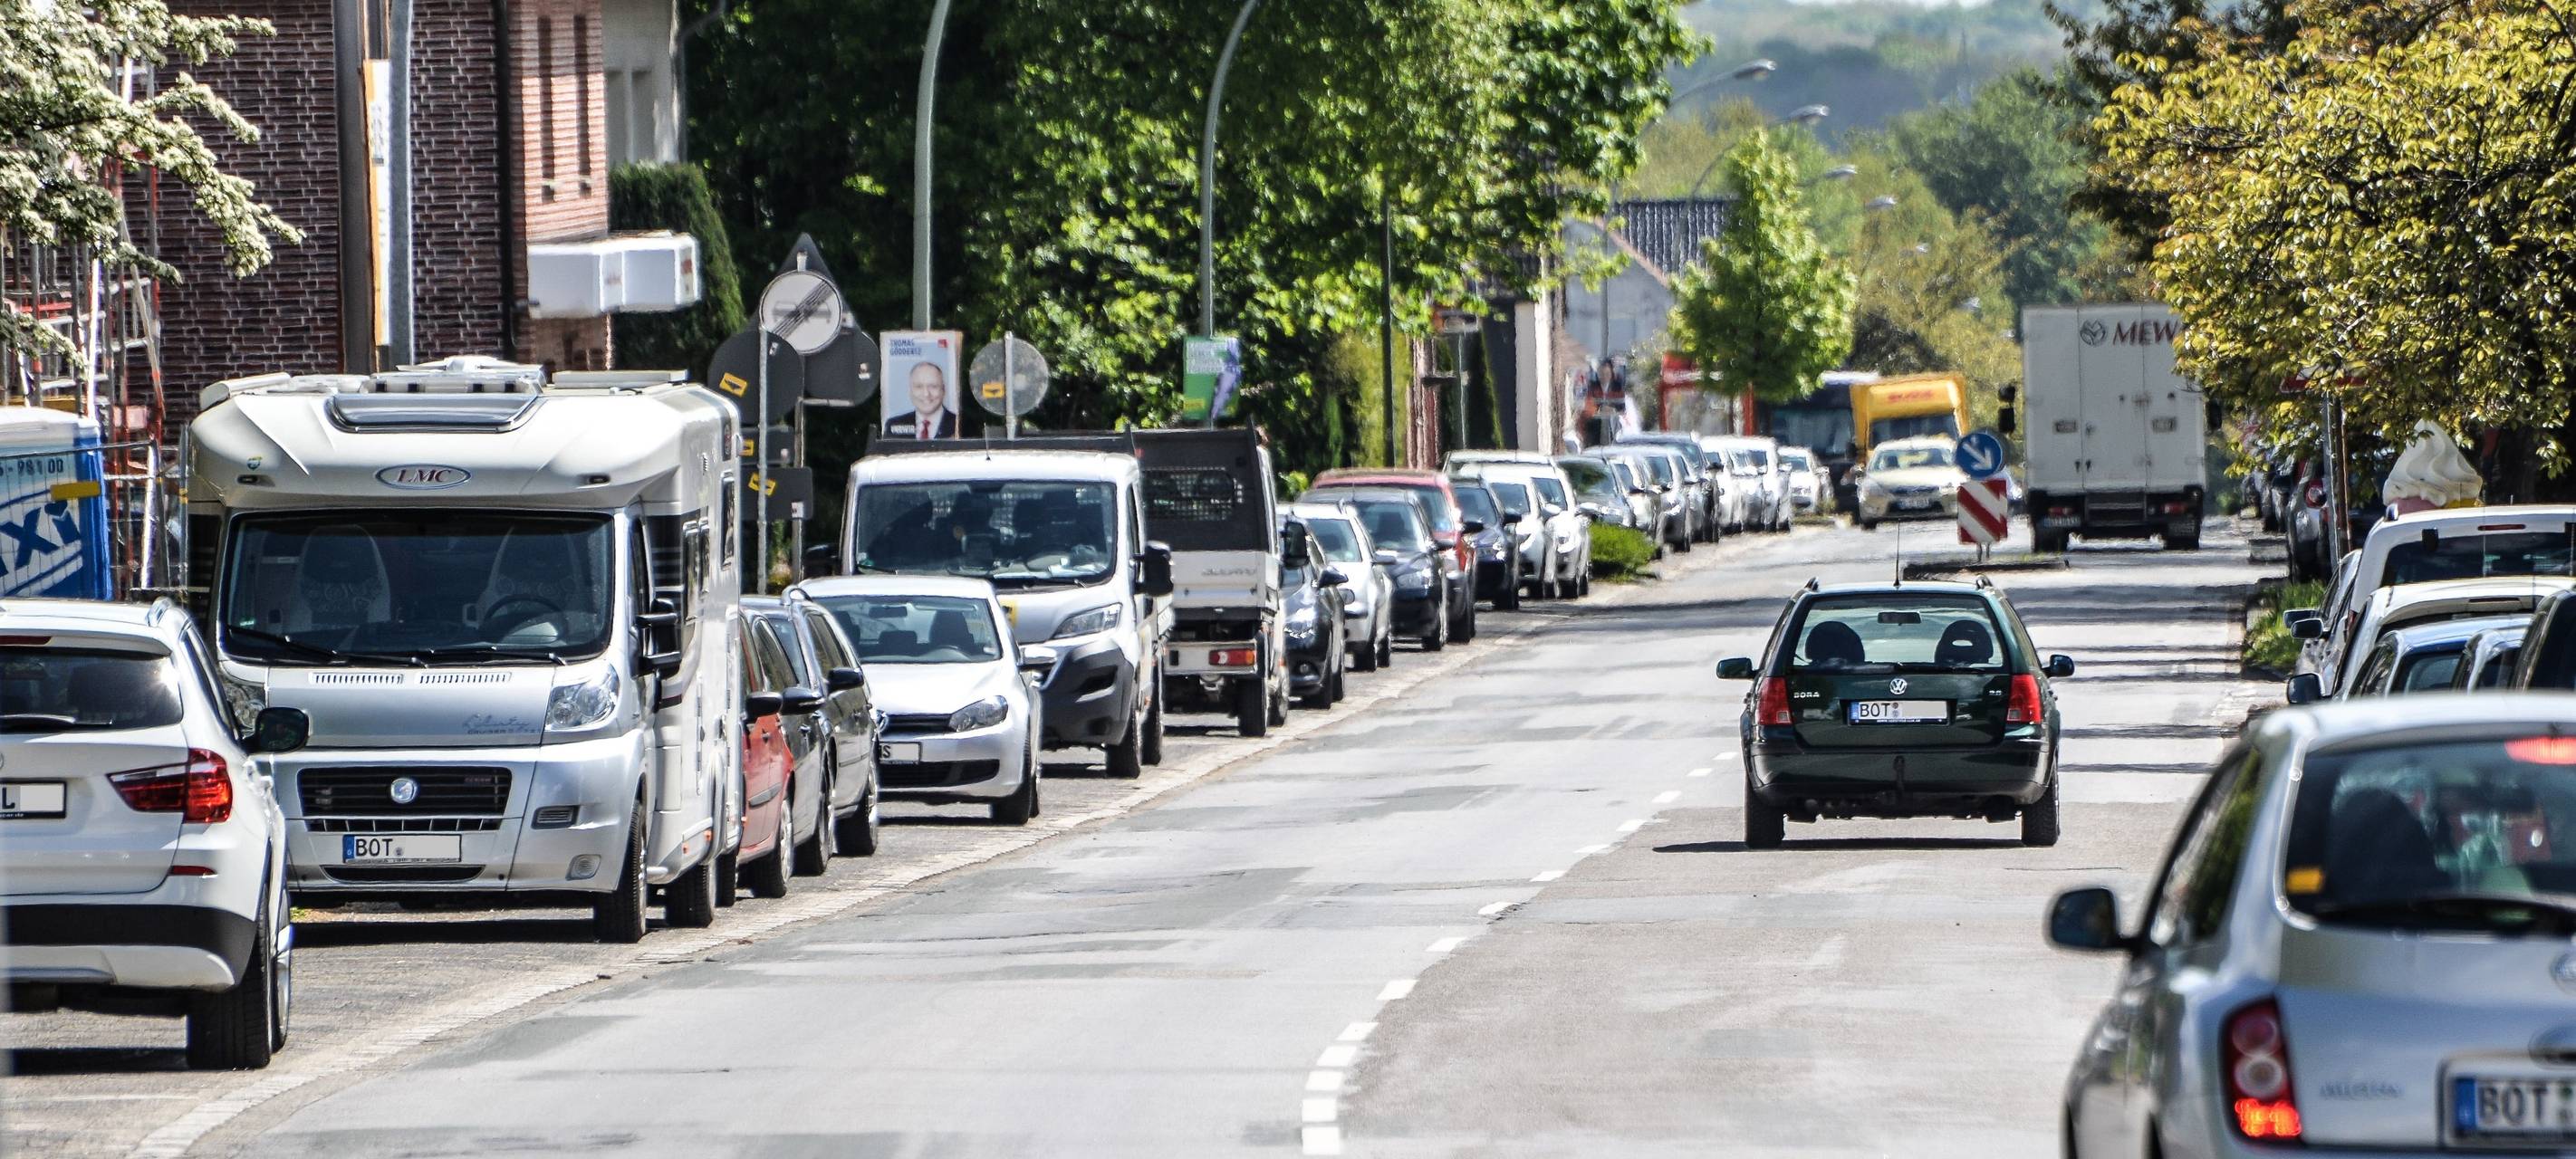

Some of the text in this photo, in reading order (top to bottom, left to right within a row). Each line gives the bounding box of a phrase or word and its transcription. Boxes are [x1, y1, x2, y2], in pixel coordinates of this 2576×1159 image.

[2112, 320, 2179, 345] MEW
[398, 469, 452, 484] LMC
[1860, 704, 1890, 717] BOT
[356, 838, 393, 857] BOT
[2478, 1087, 2548, 1125] BOT
